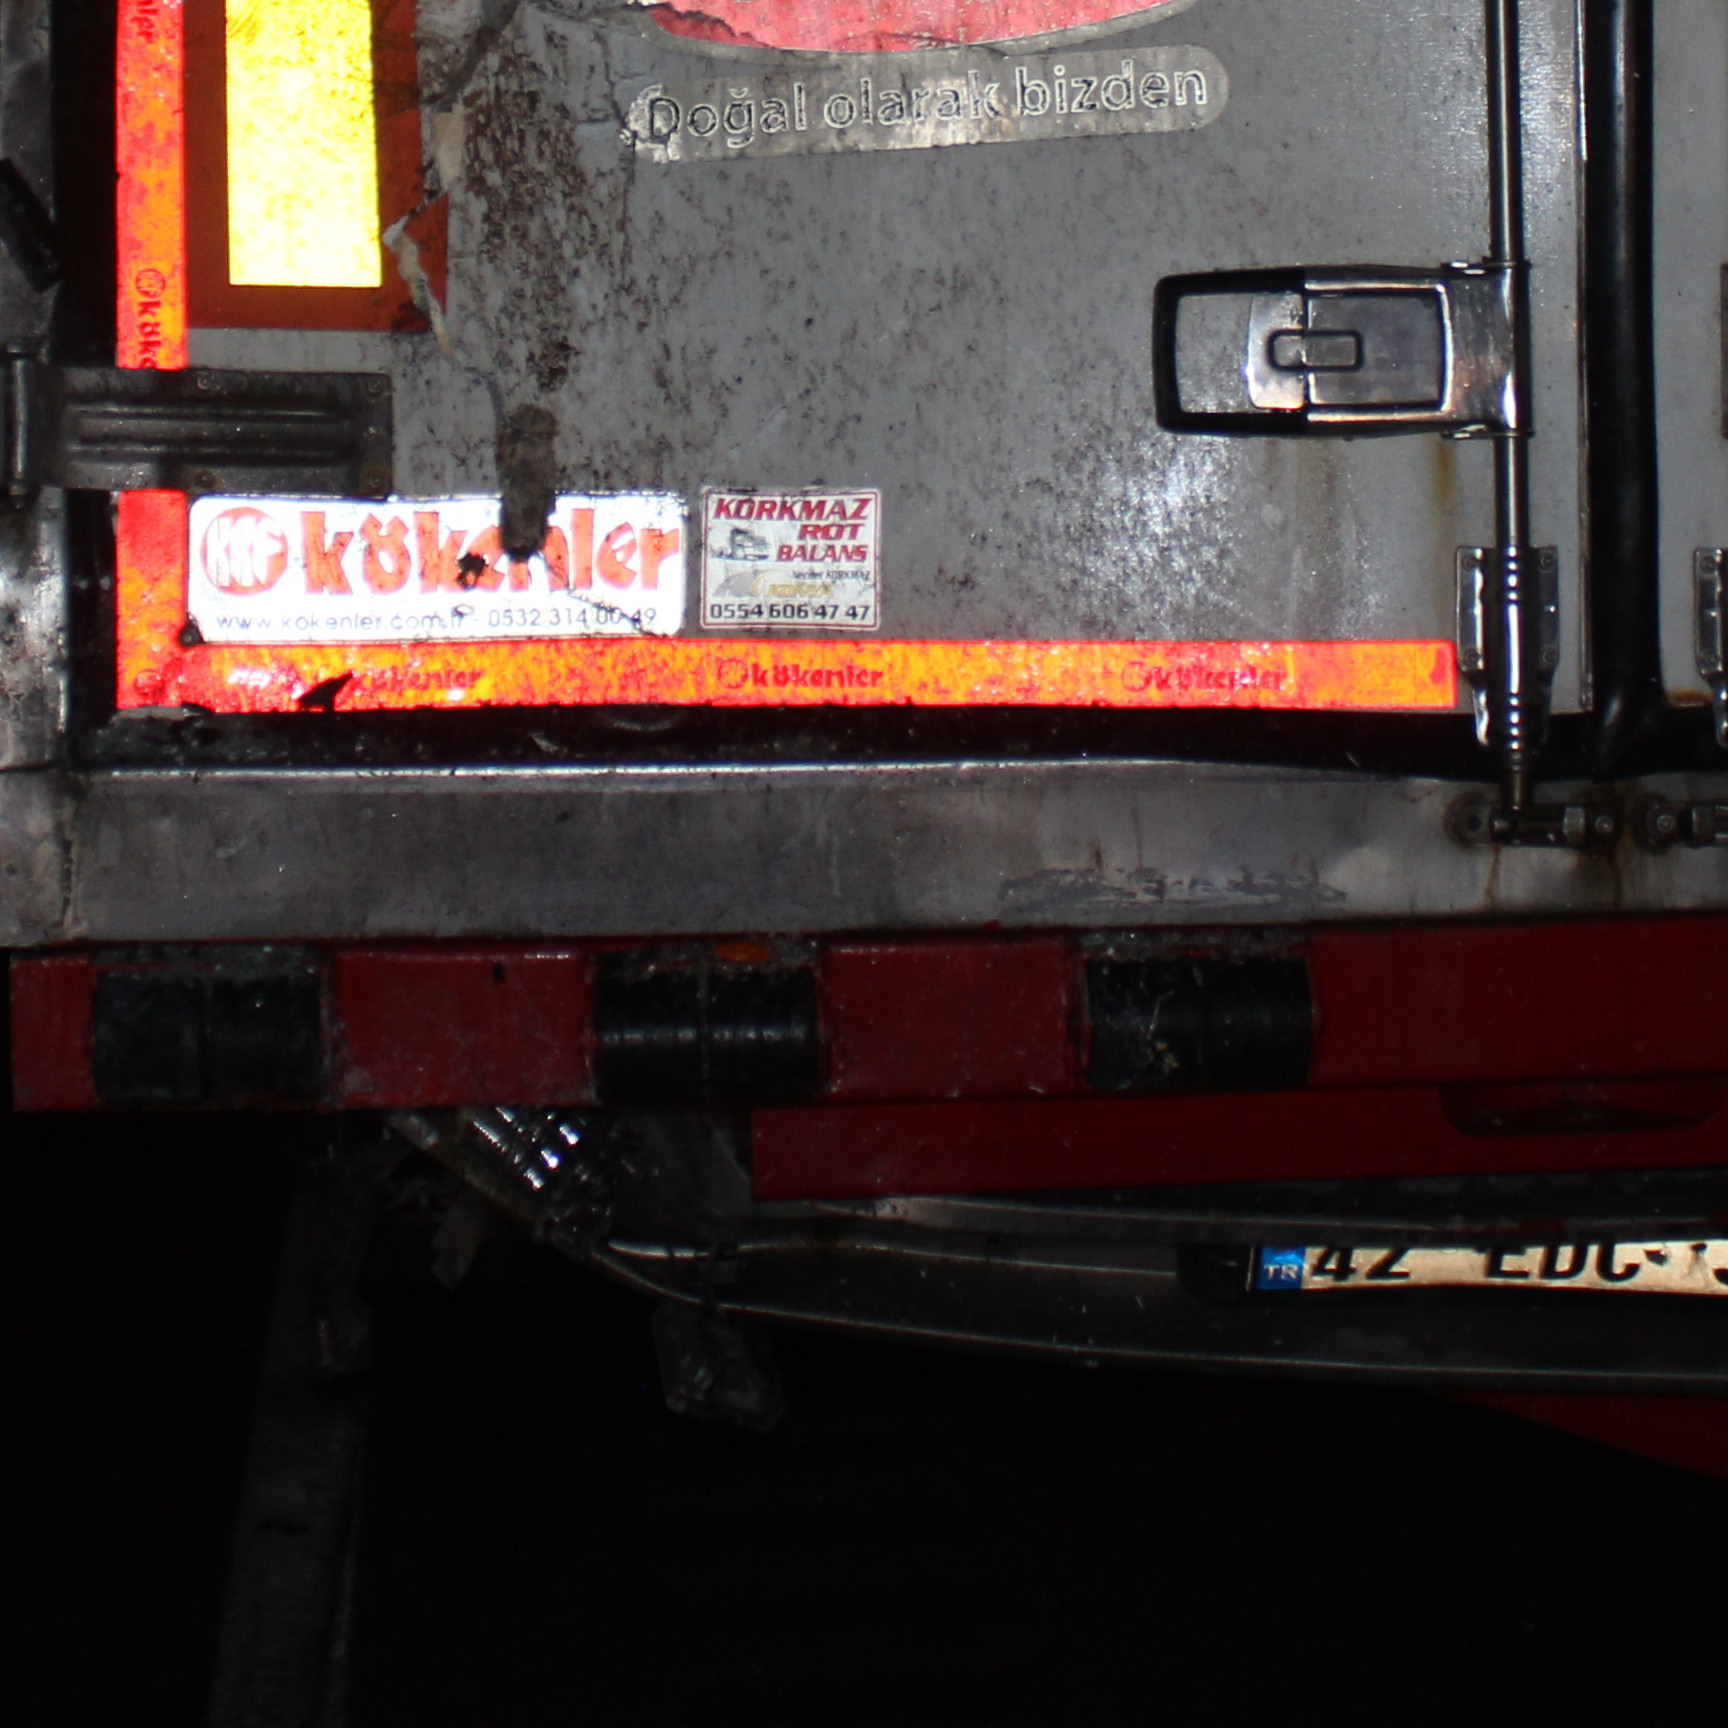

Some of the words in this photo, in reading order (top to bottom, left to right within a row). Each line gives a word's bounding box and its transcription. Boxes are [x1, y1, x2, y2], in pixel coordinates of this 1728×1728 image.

[642, 81, 807, 149] Doğal
[824, 70, 1000, 128] olarak
[1016, 59, 1207, 116] bizden
[139, 301, 162, 368] köke
[798, 523, 865, 540] ROT
[300, 508, 680, 596] kökenler
[776, 544, 868, 562] BALANS
[489, 609, 541, 627] 0532
[549, 608, 590, 626] 314
[596, 608, 622, 625] 00
[631, 607, 657, 625] 49
[710, 604, 763, 619] 0554
[770, 604, 809, 619] 606
[814, 605, 839, 619] 47
[845, 605, 870, 620] 47
[752, 662, 883, 689] kökenler
[1263, 1264, 1298, 1281] TR
